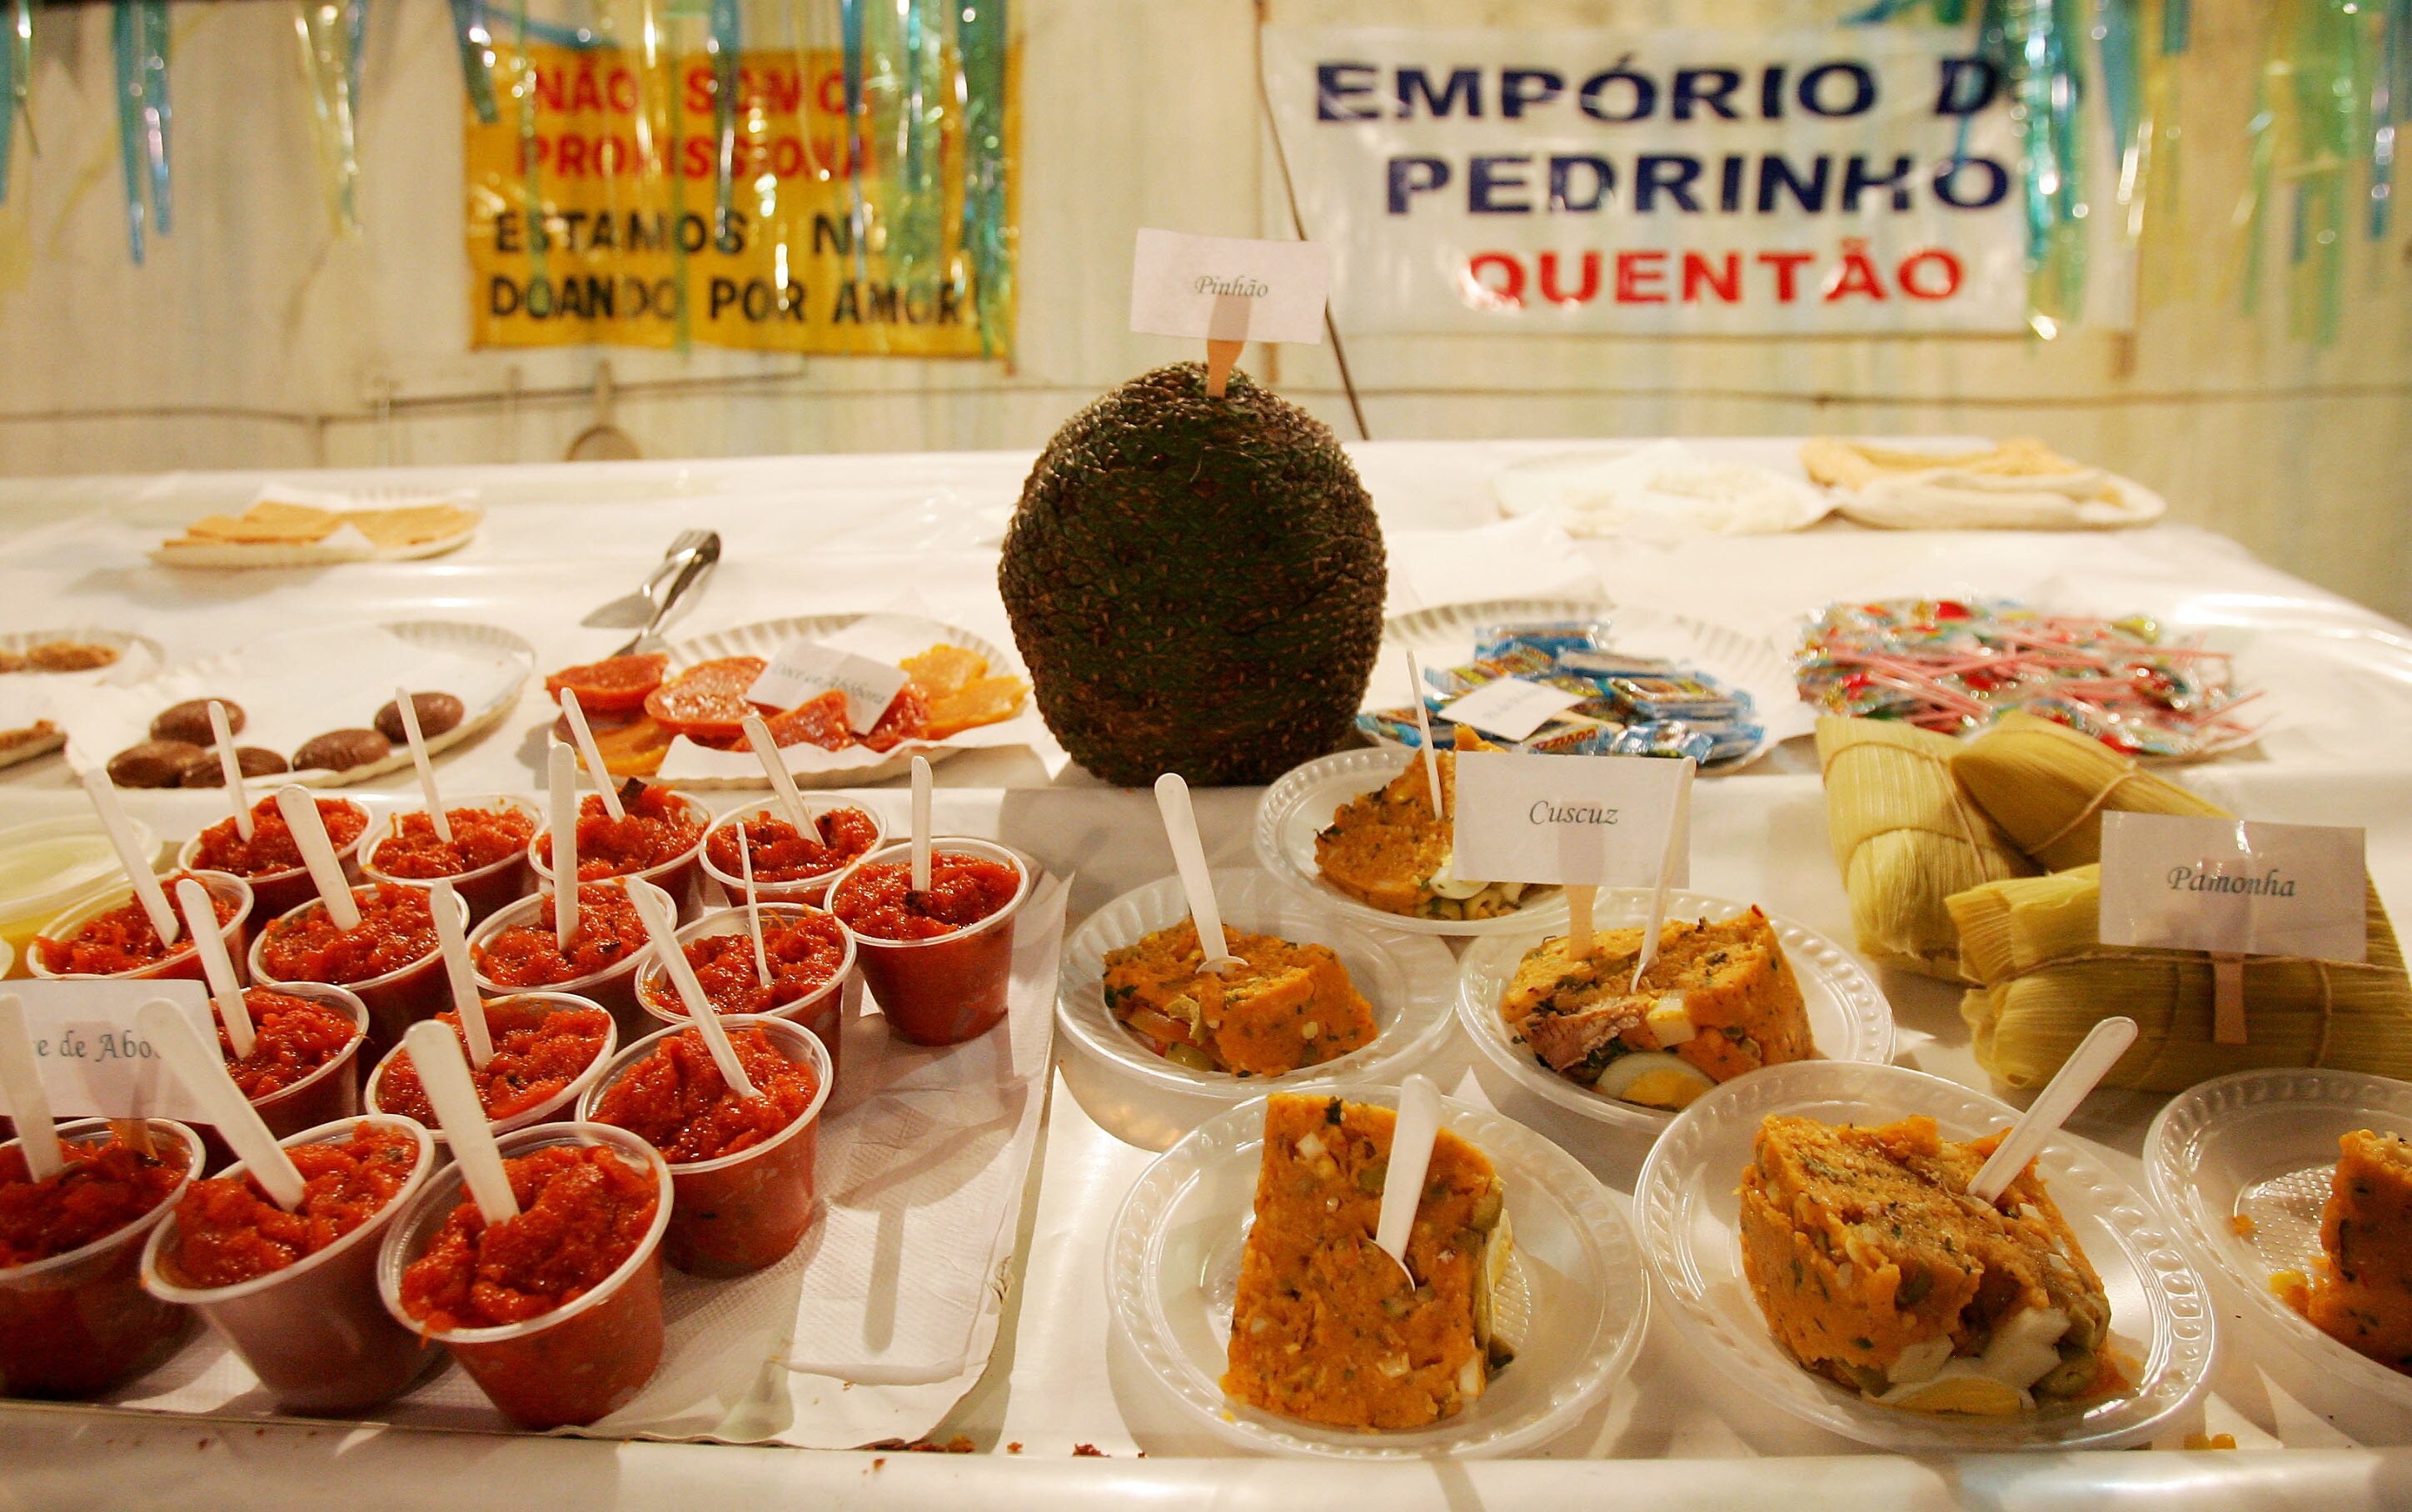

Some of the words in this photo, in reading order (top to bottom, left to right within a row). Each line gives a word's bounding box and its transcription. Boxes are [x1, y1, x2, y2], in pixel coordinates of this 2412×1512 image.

[1315, 53, 1879, 123] EMPÓRIO
[1387, 153, 2010, 216] PEDRINHO
[1194, 275, 1269, 298] Pinhão
[1466, 237, 1964, 307] QUENTÃO
[708, 276, 806, 325] POR
[1529, 800, 1619, 825] Cuscuz
[2166, 865, 2297, 898] Pamonha
[59, 1029, 87, 1058] de
